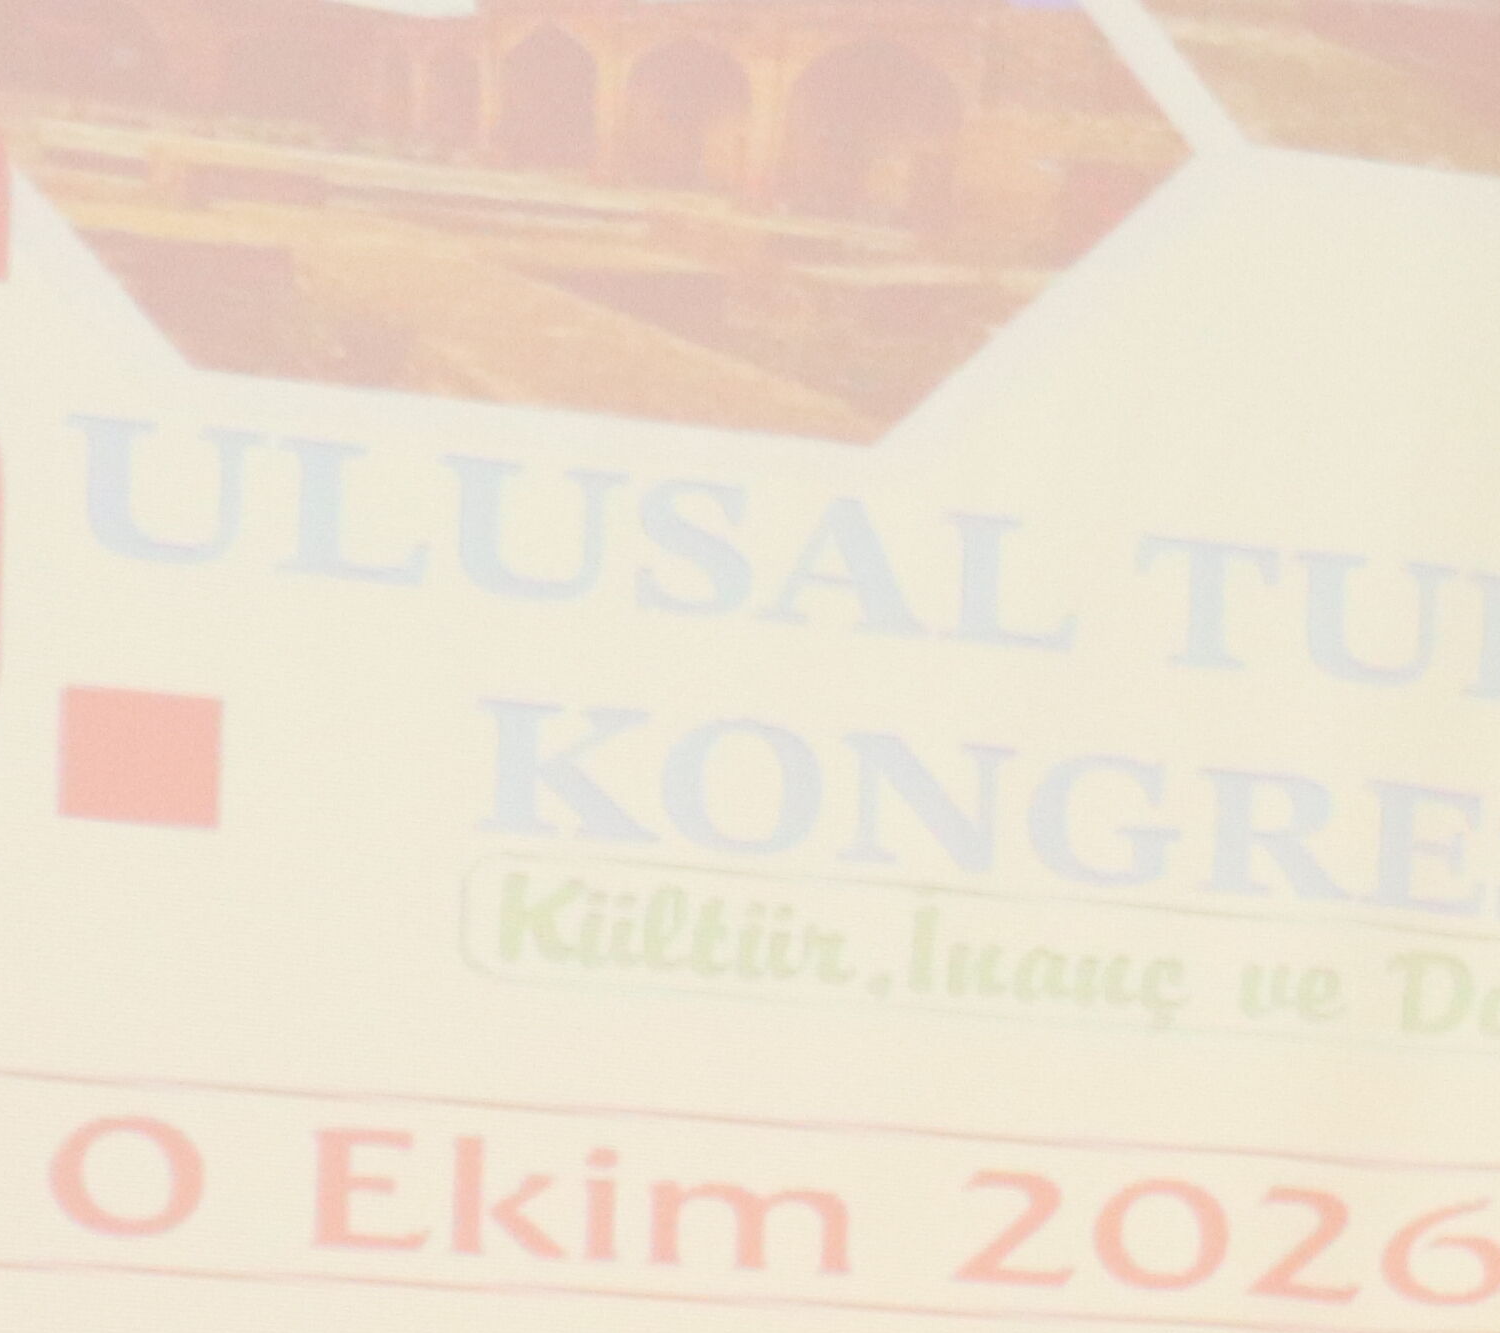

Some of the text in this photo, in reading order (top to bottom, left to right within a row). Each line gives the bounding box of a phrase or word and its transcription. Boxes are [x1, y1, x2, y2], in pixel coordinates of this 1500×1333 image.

[65, 412, 1077, 655] ULUSAL
[1237, 954, 1346, 1023] ve
[312, 1127, 852, 1277] Ekim
